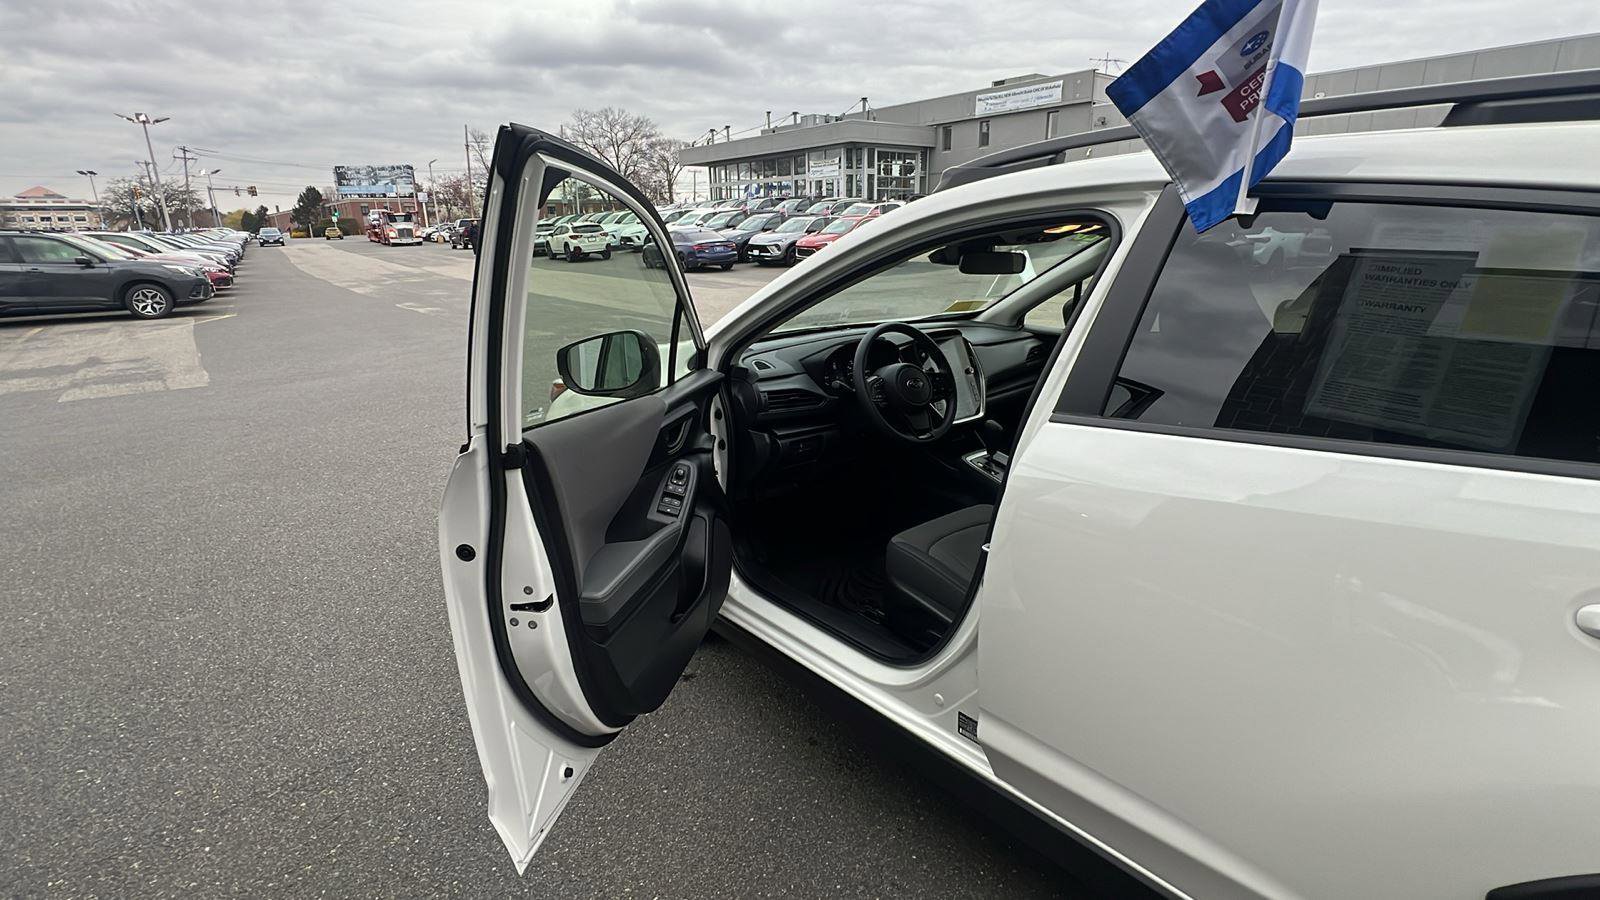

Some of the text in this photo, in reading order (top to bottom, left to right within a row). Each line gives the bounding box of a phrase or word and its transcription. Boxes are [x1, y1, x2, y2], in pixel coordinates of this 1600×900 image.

[1378, 265, 1422, 275] IMPLIED
[1365, 273, 1472, 289] WARRANTIES ONLY
[1364, 300, 1426, 313] WARRANTY
